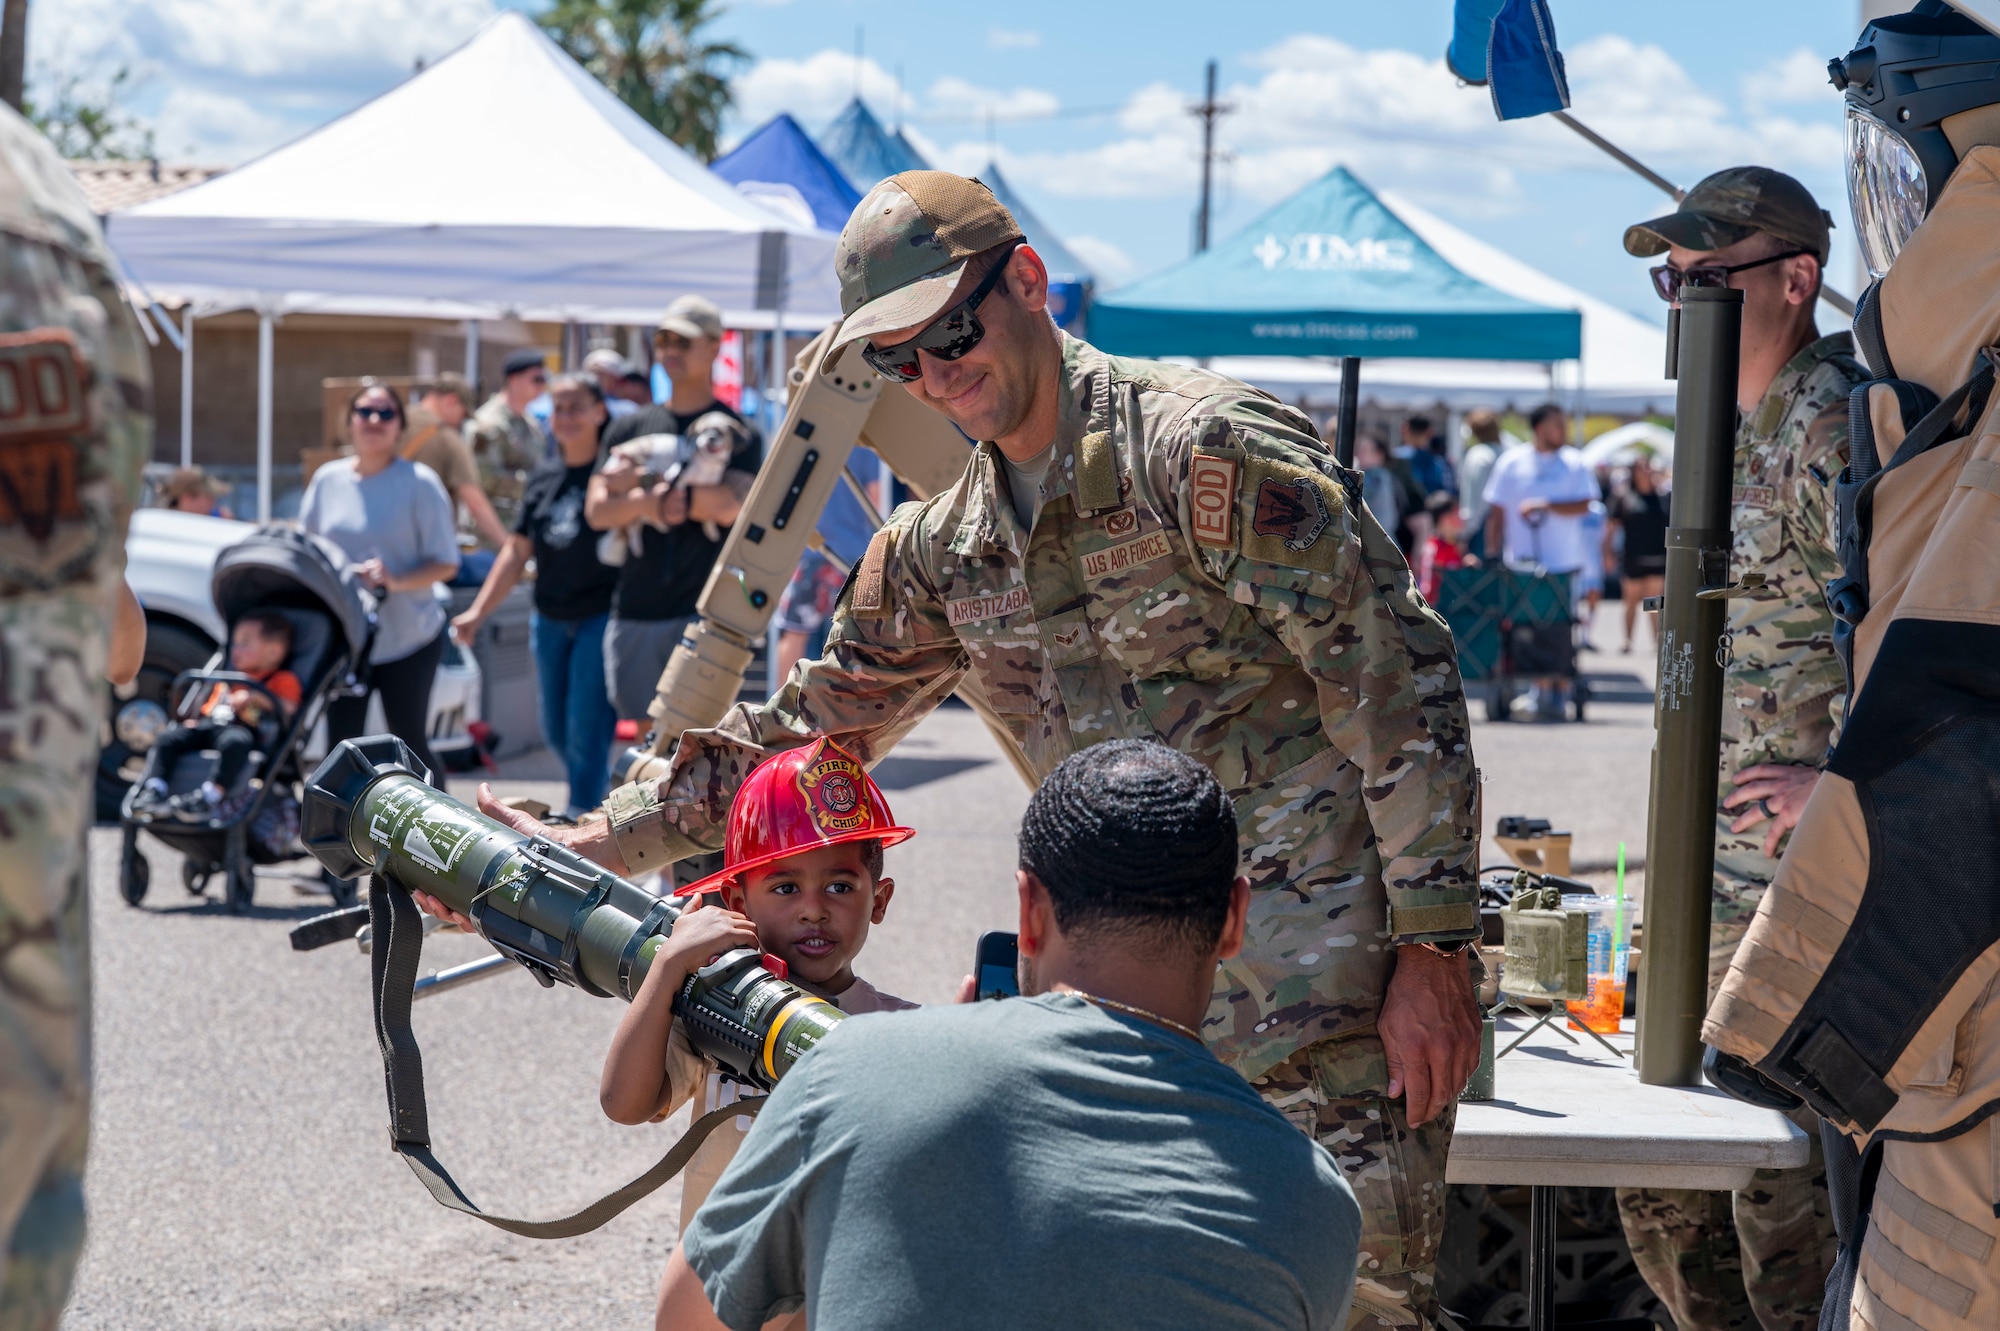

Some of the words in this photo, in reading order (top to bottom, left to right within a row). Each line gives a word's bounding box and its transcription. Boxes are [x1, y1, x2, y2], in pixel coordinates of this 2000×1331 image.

[1195, 468, 1228, 534] EOD
[1086, 555, 1109, 576] U.S.
[1110, 548, 1131, 570] AIR
[1131, 534, 1168, 562] FORCE
[817, 761, 849, 775] FIRE
[832, 814, 861, 828] CHIEF
